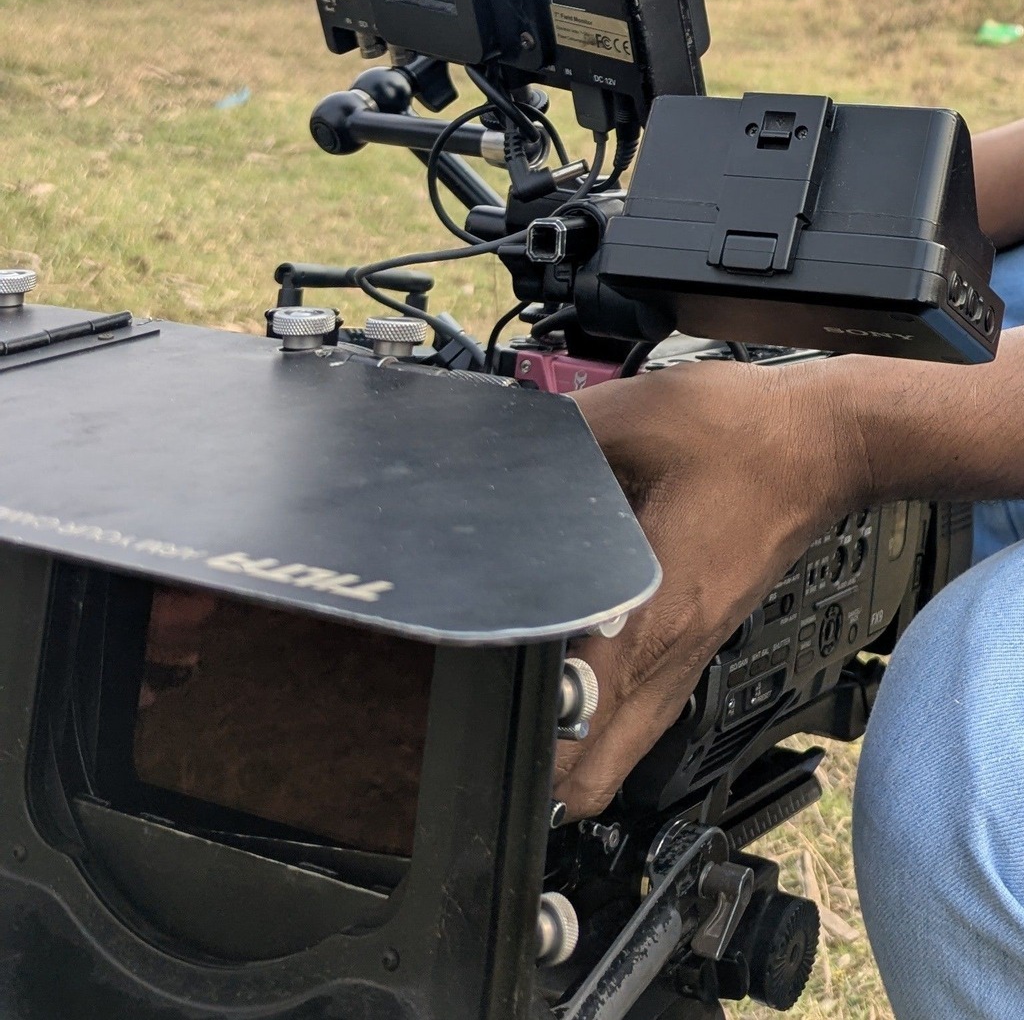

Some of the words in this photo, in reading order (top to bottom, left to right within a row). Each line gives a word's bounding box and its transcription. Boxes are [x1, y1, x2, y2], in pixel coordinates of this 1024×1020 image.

[561, 13, 573, 21] Field
[574, 17, 592, 25] Monitor
[824, 327, 914, 340] SONY
[871, 609, 884, 625] FX9
